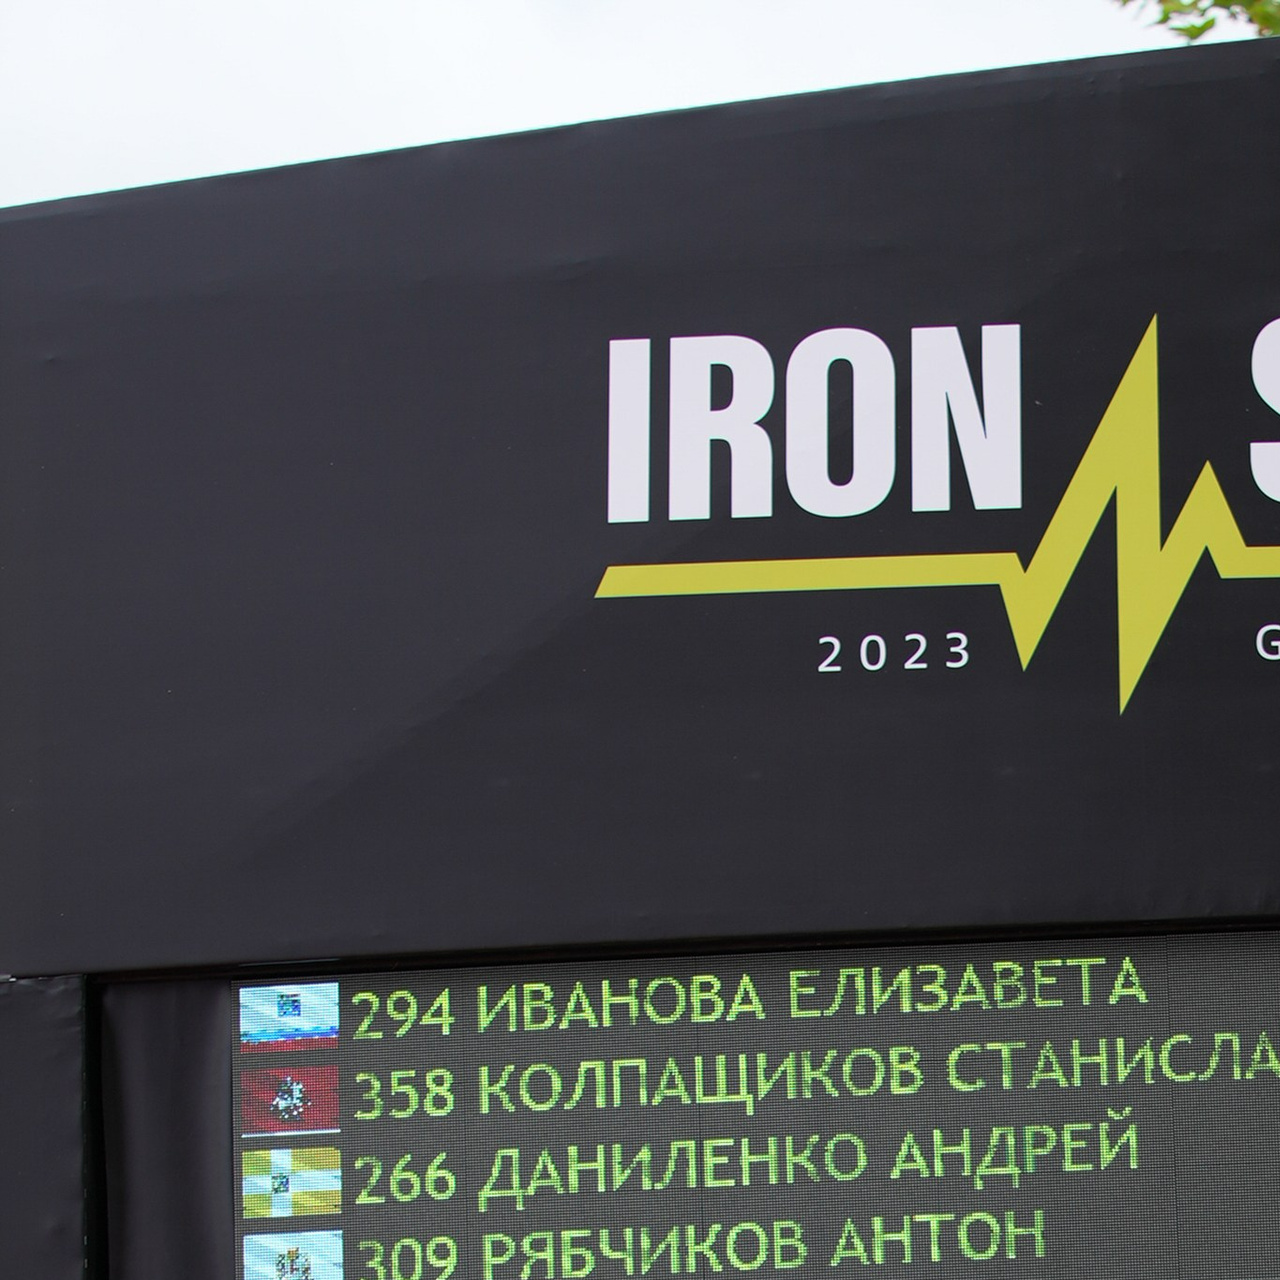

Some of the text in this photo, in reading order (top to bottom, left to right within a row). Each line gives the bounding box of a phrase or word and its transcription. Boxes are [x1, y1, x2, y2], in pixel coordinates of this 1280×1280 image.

[606, 323, 1022, 525] IRON
[817, 632, 969, 673] 2023
[351, 987, 456, 1040] 294
[476, 973, 767, 1033] ИВАНОВА
[788, 955, 1149, 1019] ЕЛИЗАВЕТА
[354, 1066, 456, 1121] 358
[478, 1044, 925, 1116] КОЛПАЩИКОВ
[354, 1151, 458, 1205] 266
[477, 1131, 869, 1212] ДАНИЛЕНКО
[889, 1107, 1141, 1190] АНДРЕЙ
[829, 1209, 1047, 1268] АНТОН
